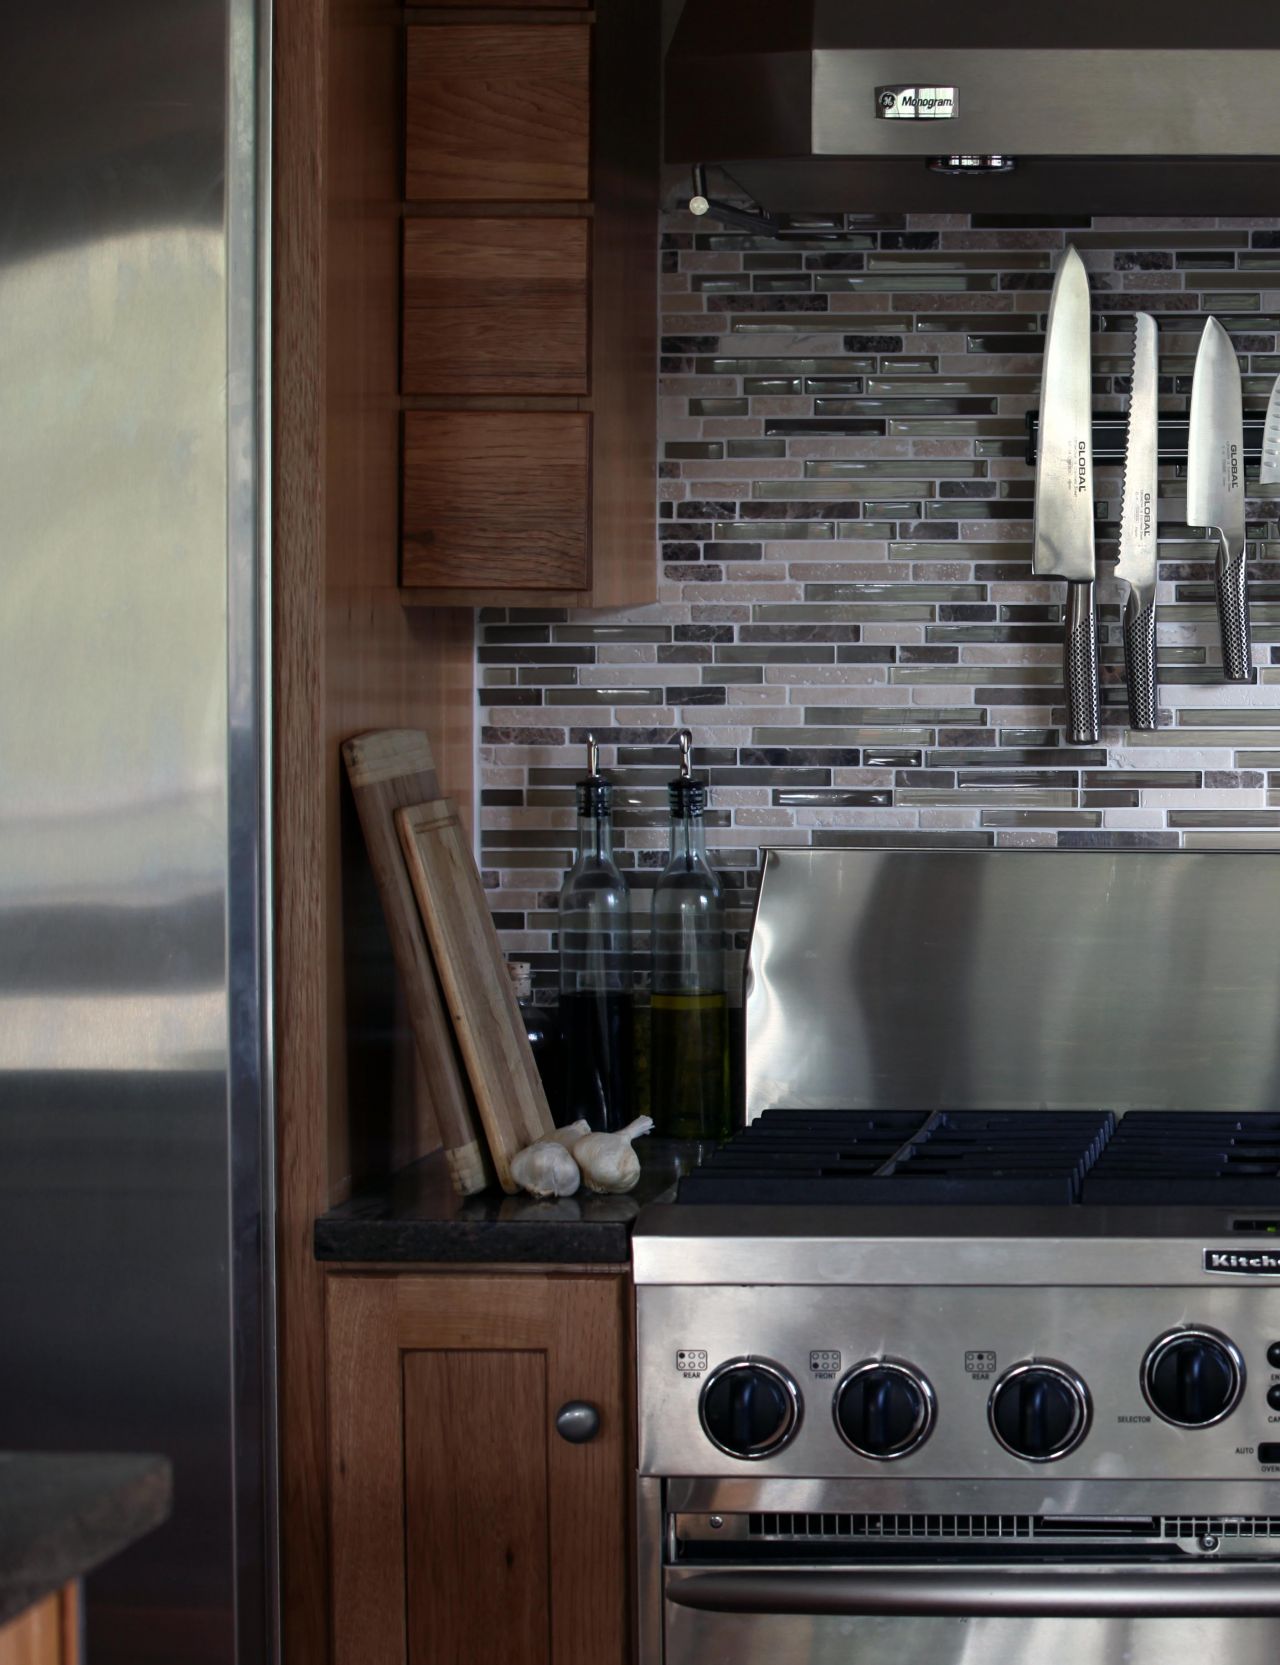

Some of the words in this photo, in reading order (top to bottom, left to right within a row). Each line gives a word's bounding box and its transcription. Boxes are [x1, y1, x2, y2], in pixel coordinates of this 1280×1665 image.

[901, 96, 953, 109] Monogram
[1078, 441, 1086, 492] GLOBAL
[1235, 1447, 1254, 1455] AUTO
[1260, 1465, 1280, 1473] OVEN
